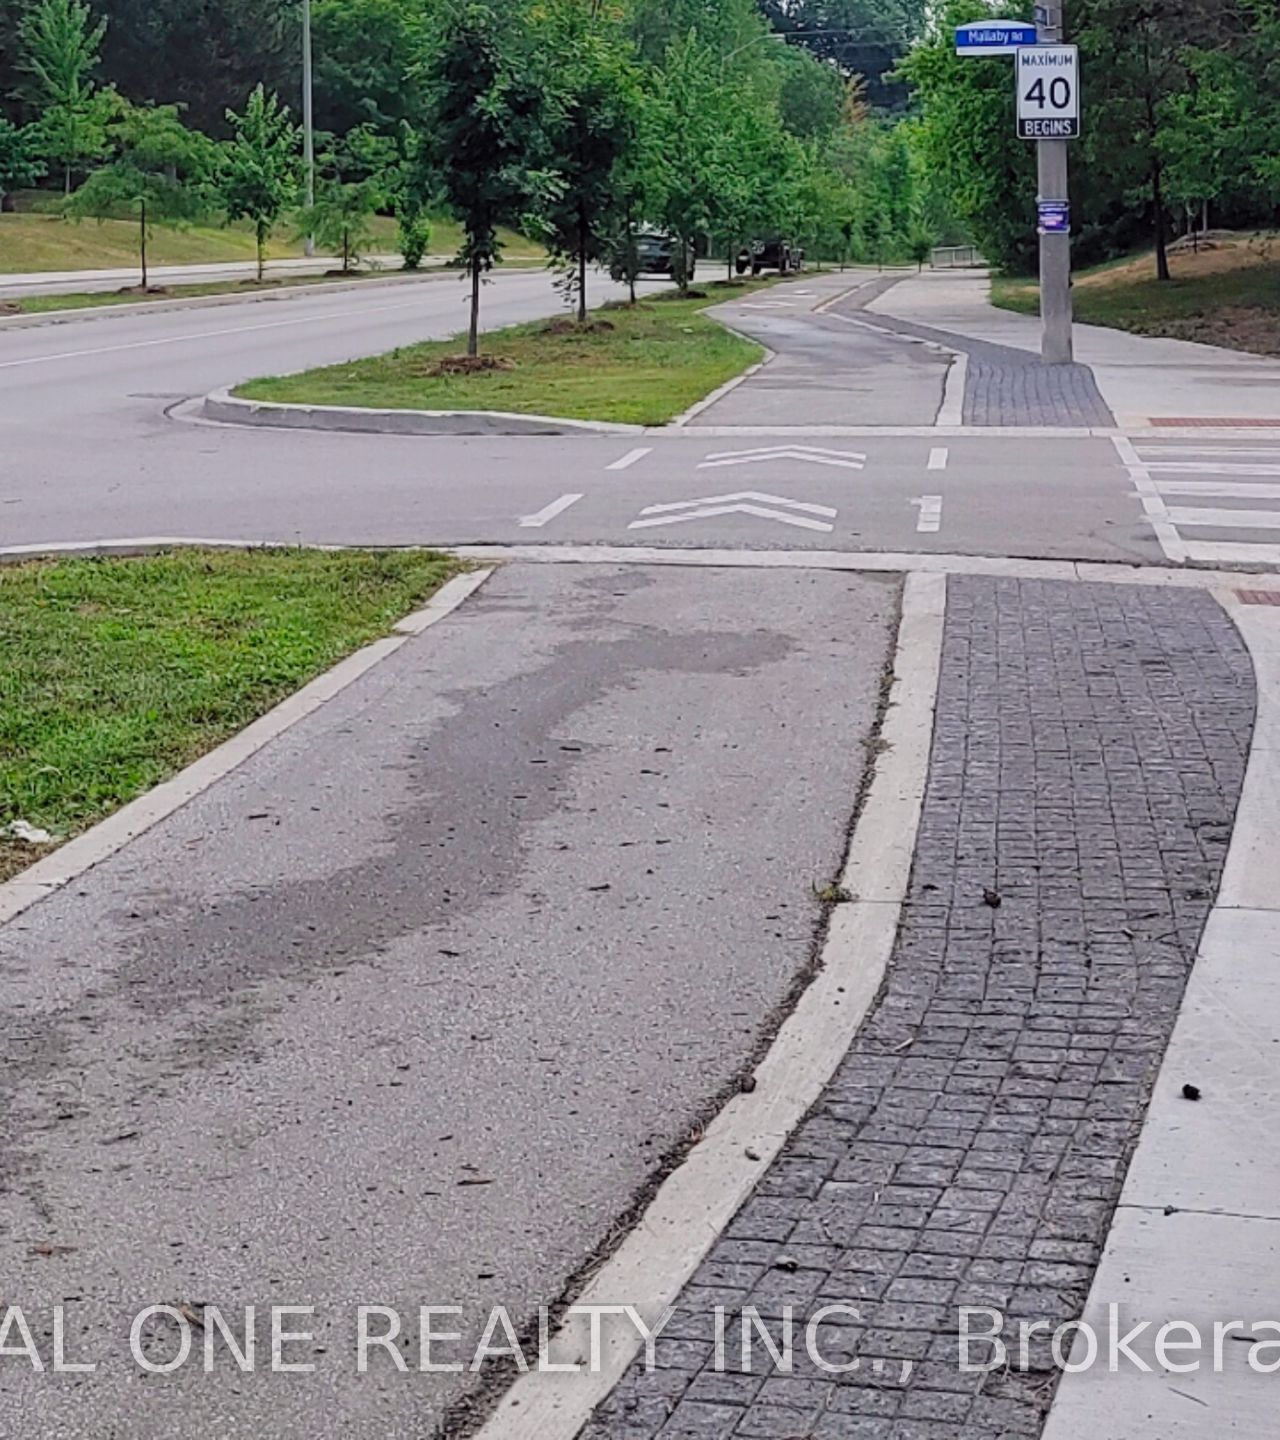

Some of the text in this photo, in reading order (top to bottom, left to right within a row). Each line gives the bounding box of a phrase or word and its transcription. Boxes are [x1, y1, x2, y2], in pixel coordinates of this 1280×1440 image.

[1022, 54, 1073, 66] MAXIMUM
[1024, 76, 1071, 109] 40
[1024, 120, 1071, 135] BEGINS
